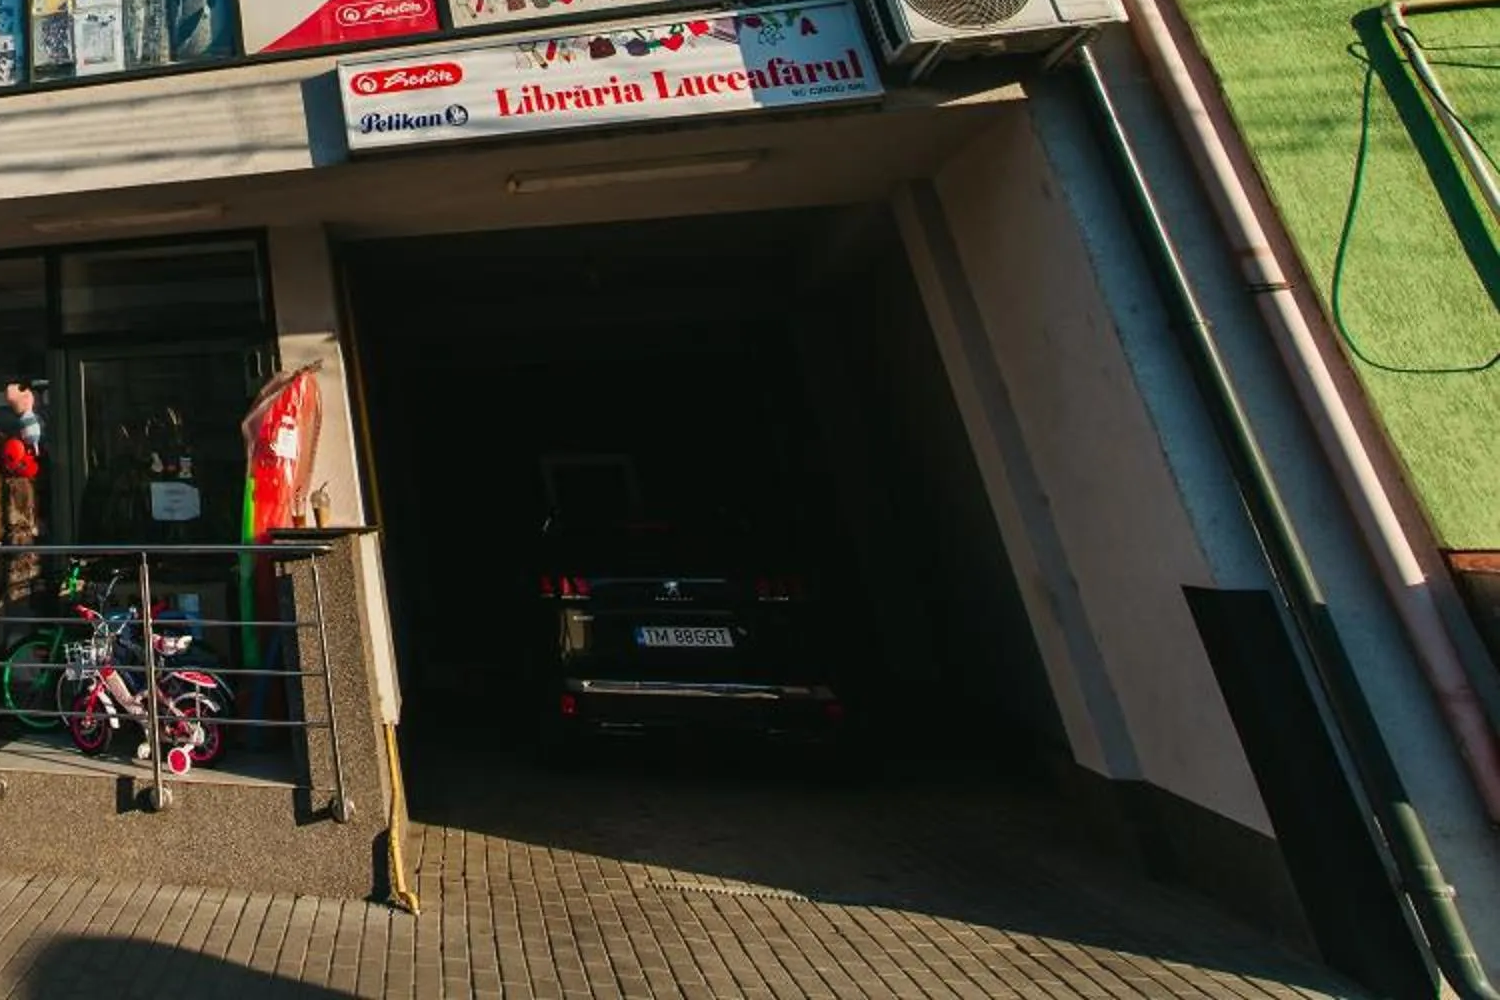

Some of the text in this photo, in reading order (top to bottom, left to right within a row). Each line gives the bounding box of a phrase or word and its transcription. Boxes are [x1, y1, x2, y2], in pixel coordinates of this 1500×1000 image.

[495, 48, 865, 118] Librăria Luceafărul
[360, 110, 442, 134] Pelikan
[646, 629, 669, 645] TM
